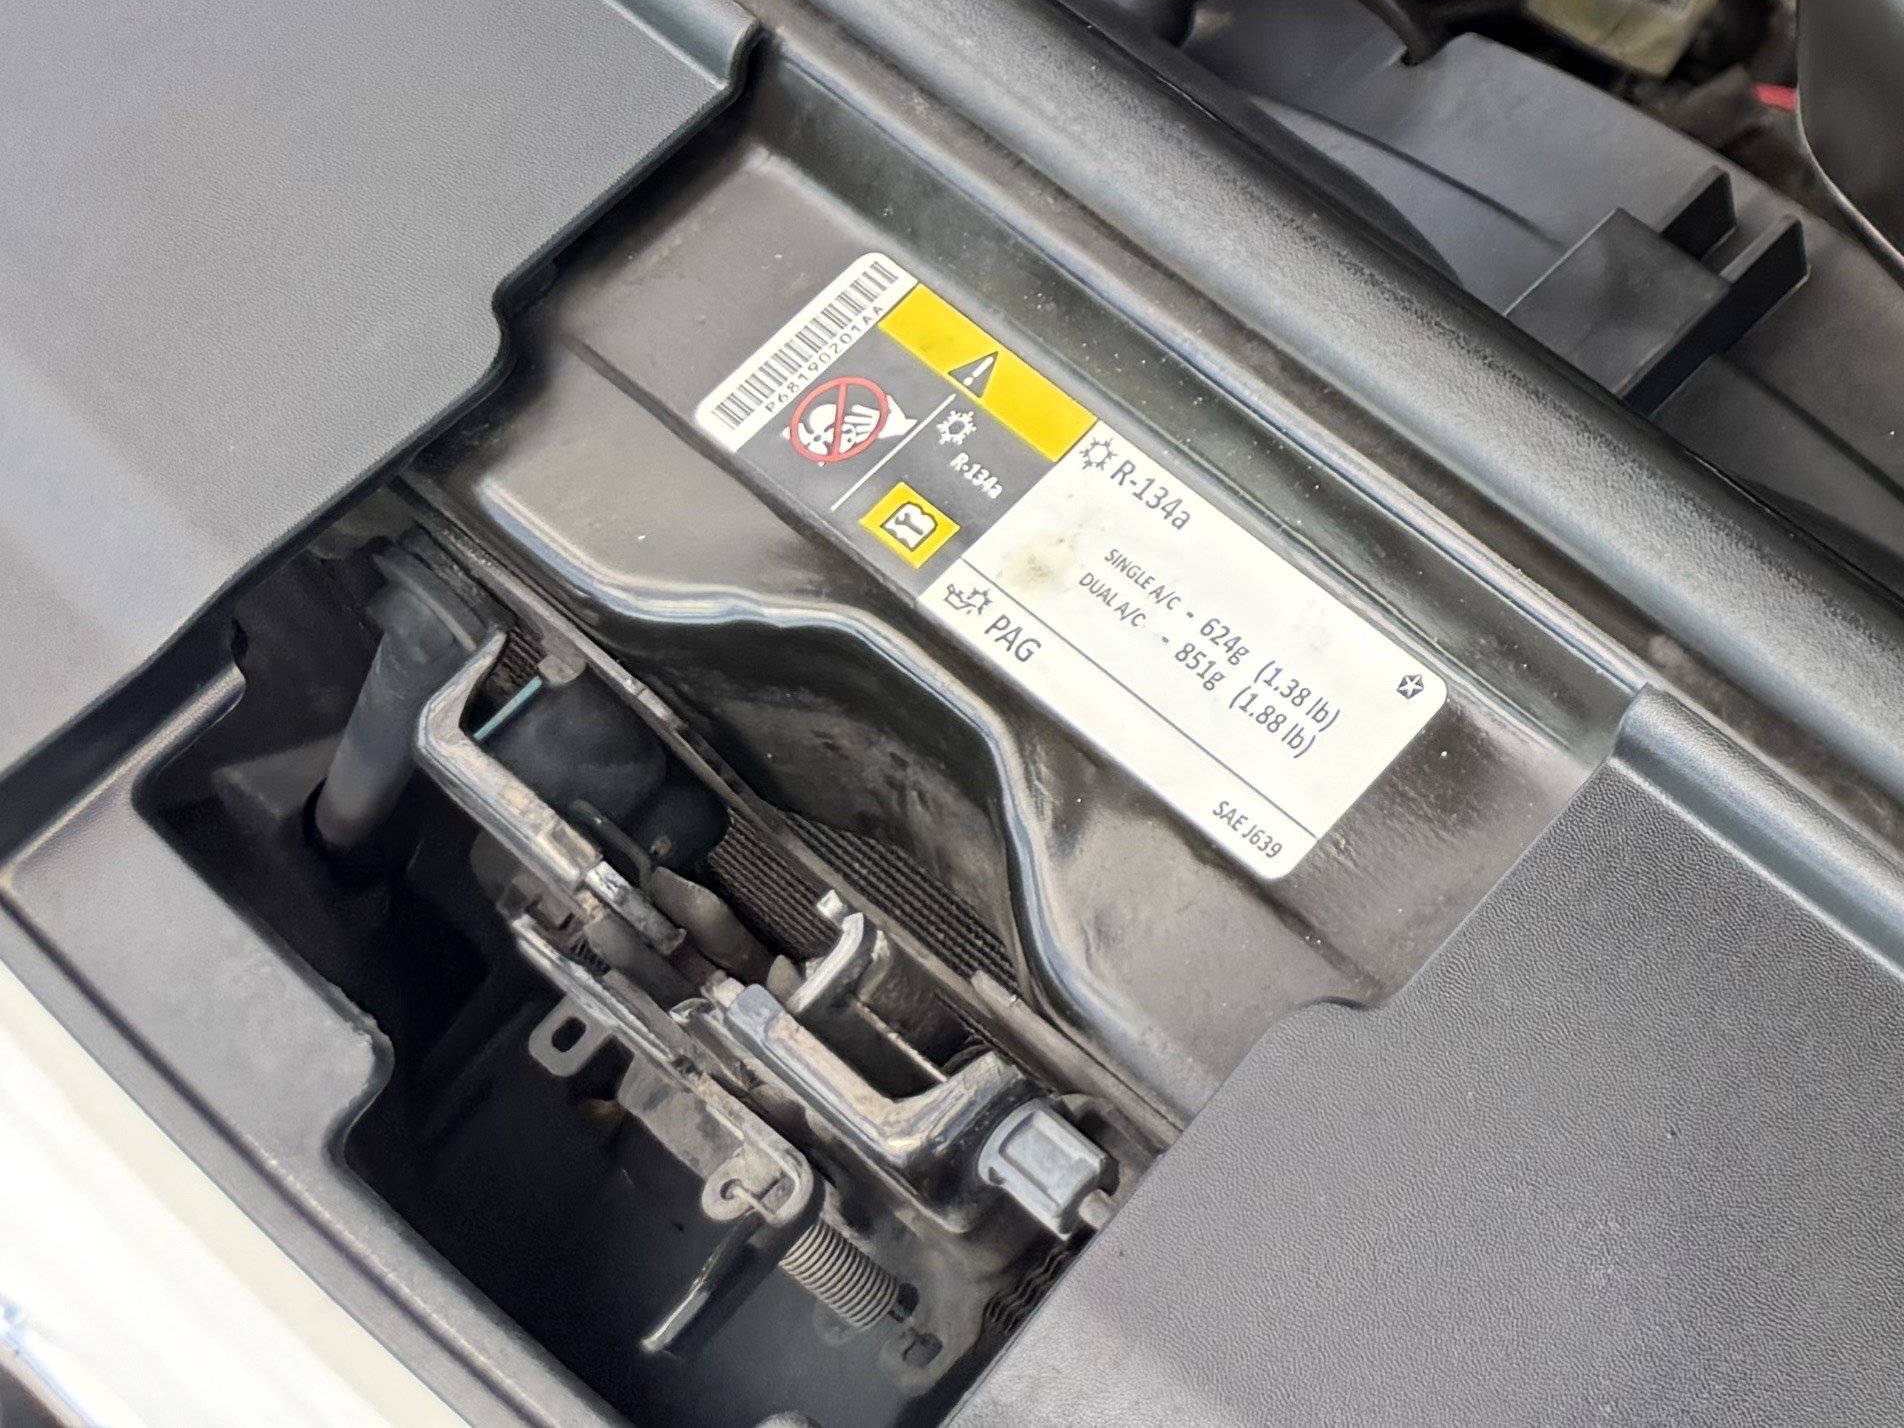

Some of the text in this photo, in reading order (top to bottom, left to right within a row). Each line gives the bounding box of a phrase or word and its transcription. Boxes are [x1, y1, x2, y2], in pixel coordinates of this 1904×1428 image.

[949, 450, 1005, 499] R-134a
[1108, 458, 1194, 533] R-134a
[982, 616, 1042, 665] PAG
[1078, 571, 1123, 612] DUAL
[1111, 598, 1148, 631] A/C
[1173, 643, 1226, 692] 851g
[1229, 685, 1282, 733] (1.88
[1277, 723, 1319, 760] lb)
[1104, 546, 1159, 594] SINGLE
[1148, 580, 1185, 615] A/C
[1198, 619, 1251, 668] 624g
[1254, 659, 1309, 709] (1.38
[1304, 697, 1344, 733] lb)
[1211, 797, 1285, 862] SAE J639
